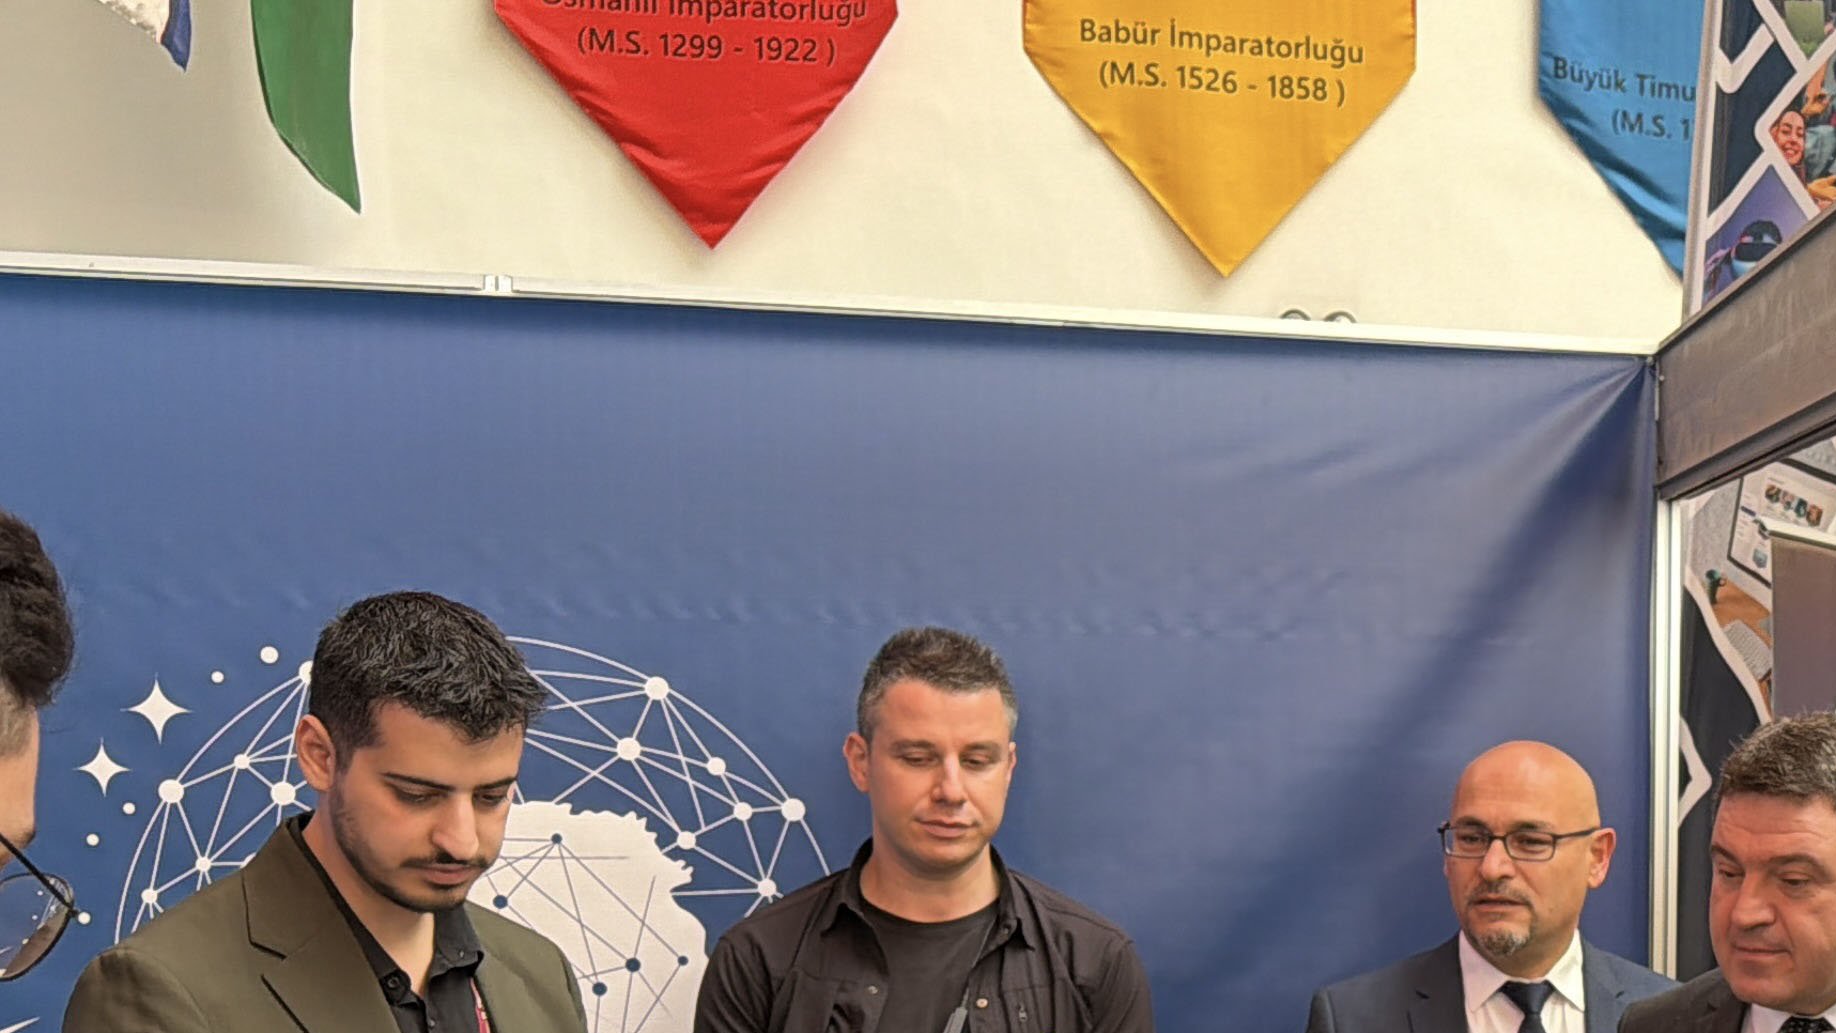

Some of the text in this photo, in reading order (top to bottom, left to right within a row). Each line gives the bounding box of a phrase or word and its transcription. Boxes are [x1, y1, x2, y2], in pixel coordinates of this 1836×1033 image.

[578, 26, 649, 55] (M.S.
[659, 32, 723, 59] 1299
[754, 36, 818, 62] 1922
[827, 38, 836, 67] )
[1079, 18, 1364, 69] Babür İmparatorluğu
[1099, 61, 1167, 89] (M.S.
[1176, 66, 1238, 94] 1526
[1268, 75, 1328, 101] 1858
[1336, 79, 1346, 107] )
[1553, 56, 1627, 93] Büyük
[1612, 109, 1672, 139] (M.S.
